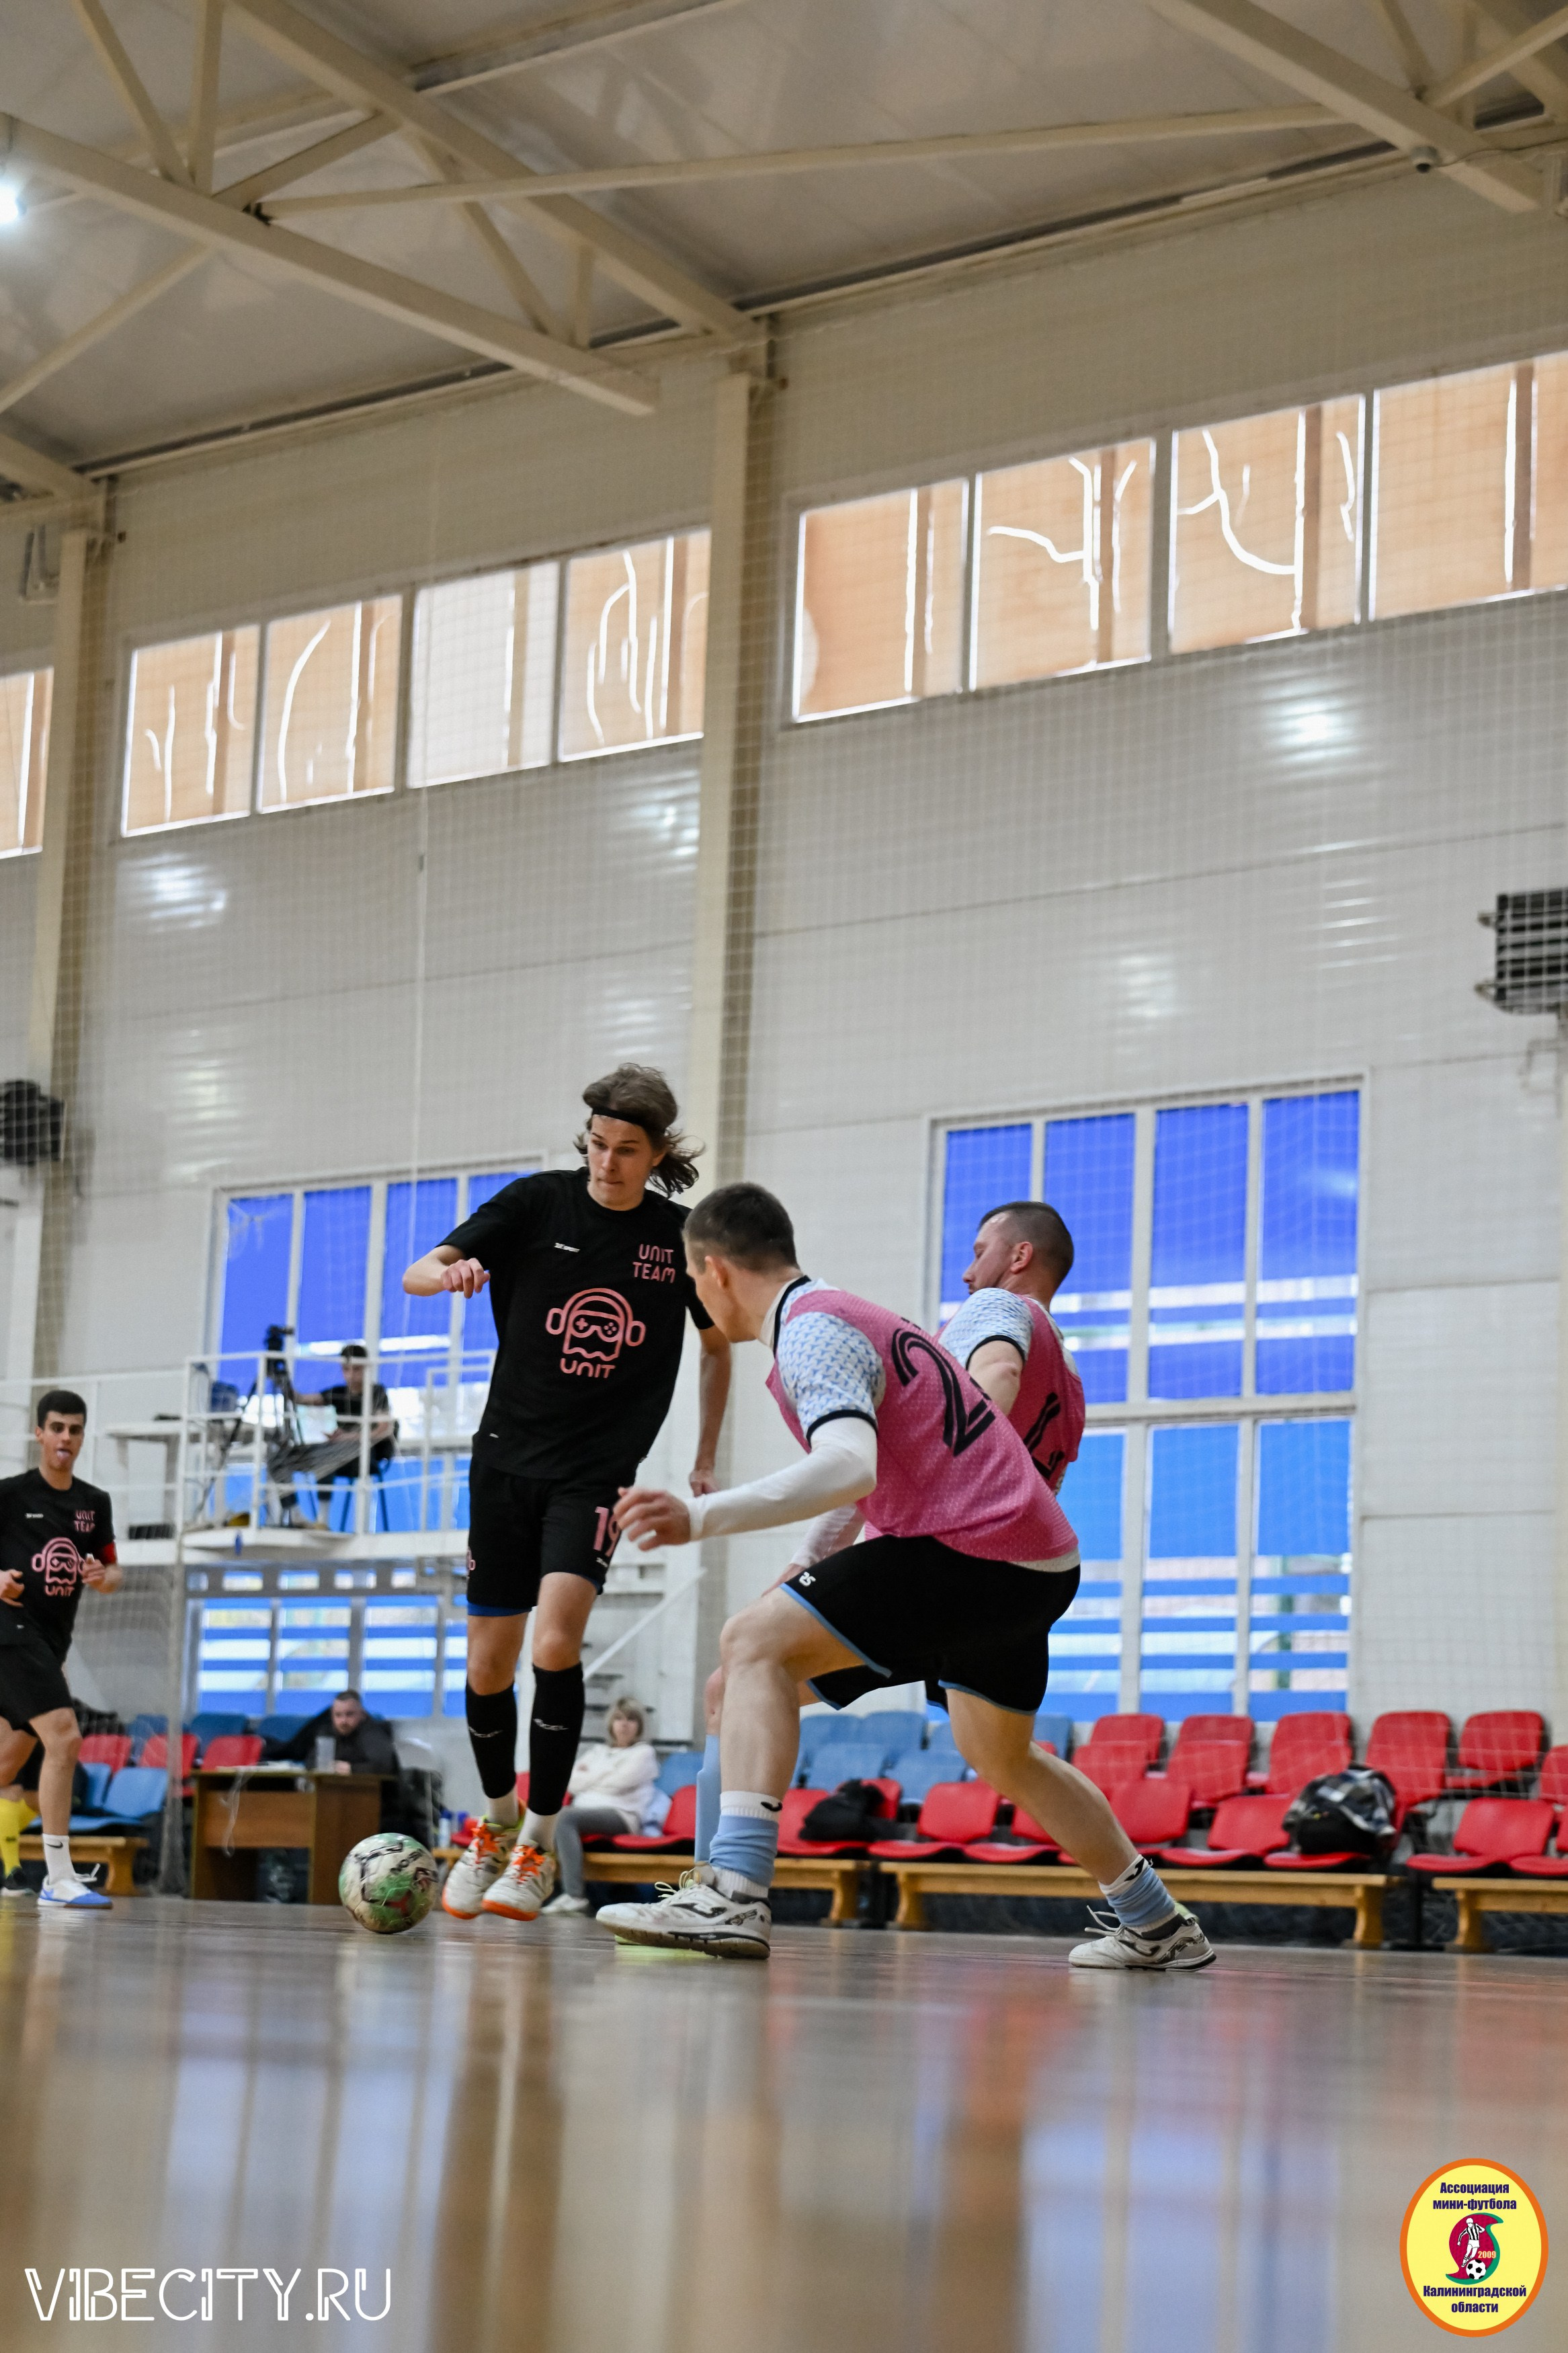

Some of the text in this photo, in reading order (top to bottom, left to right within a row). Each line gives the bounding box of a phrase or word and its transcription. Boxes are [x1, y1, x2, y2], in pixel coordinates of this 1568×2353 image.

[638, 1244, 674, 1264] UNIT
[632, 1261, 676, 1283] TEAM
[560, 1357, 616, 1379] UNIT
[75, 1509, 95, 1521] UNIT
[45, 1585, 75, 1597] UNIT
